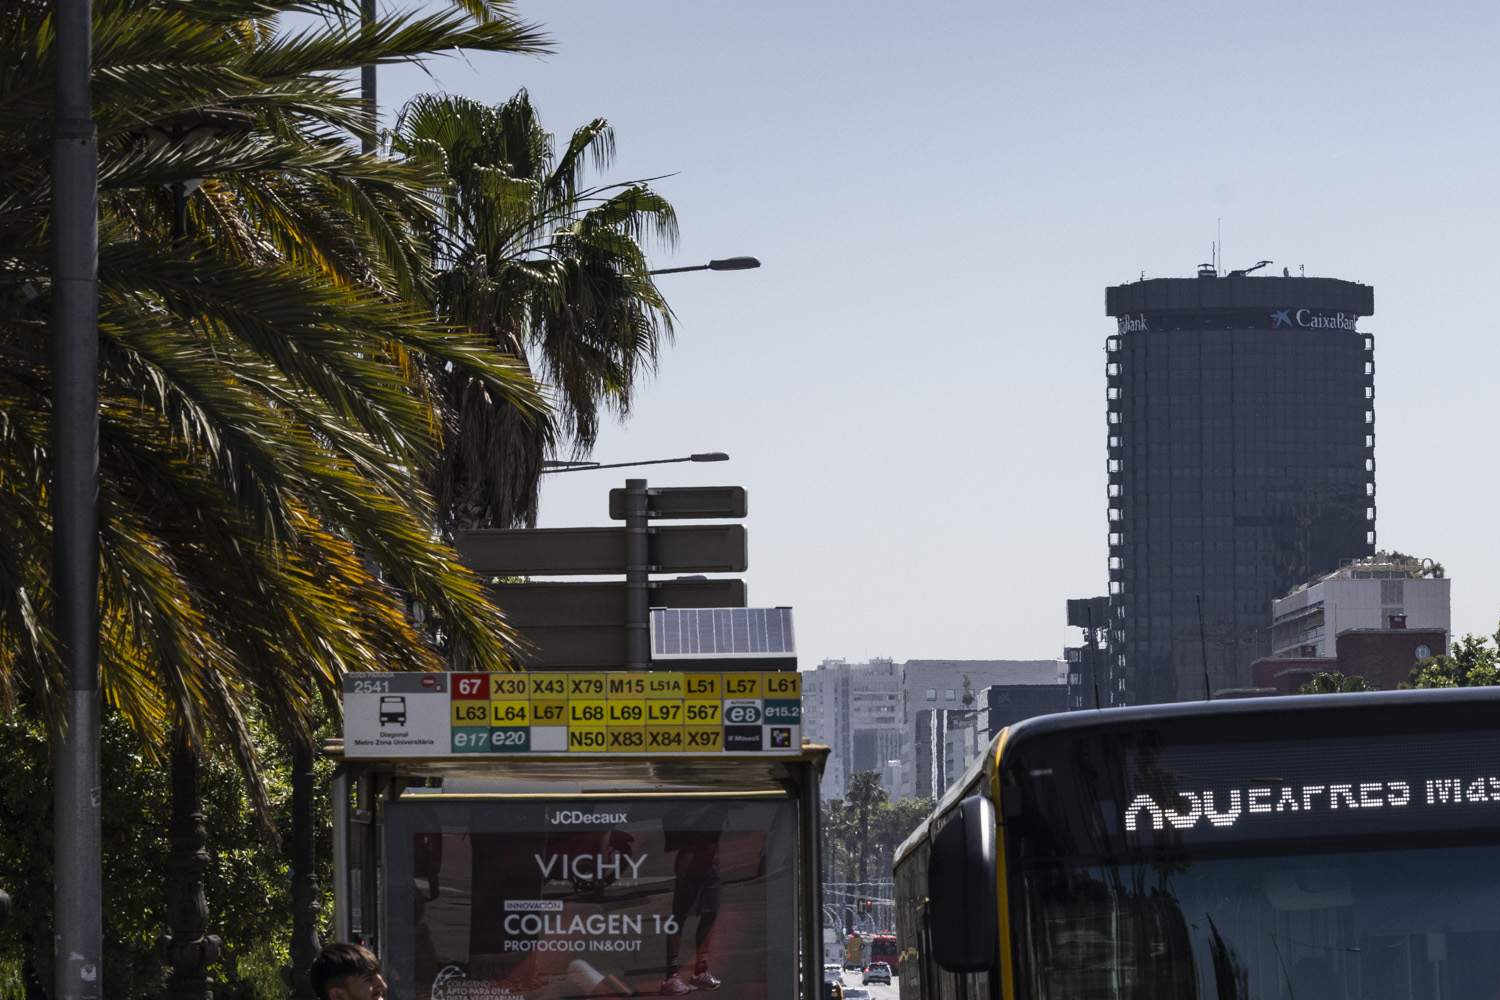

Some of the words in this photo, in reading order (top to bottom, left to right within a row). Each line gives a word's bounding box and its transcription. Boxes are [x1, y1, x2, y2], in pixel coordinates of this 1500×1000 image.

[1296, 309, 1357, 331] CaixaBank
[354, 681, 389, 693] 2541
[459, 679, 481, 694] 67
[494, 680, 526, 694] X30
[533, 680, 565, 694] X43
[571, 680, 603, 694] X79
[610, 679, 645, 693] M15
[650, 681, 681, 691] L51A
[687, 680, 714, 693] L51
[727, 680, 756, 693] L57
[768, 679, 797, 692] L61
[456, 707, 487, 720] L63
[494, 707, 527, 721] L64
[534, 706, 564, 720] L67
[572, 706, 604, 720] L68
[610, 706, 642, 720] L69
[648, 705, 681, 720] L97
[687, 705, 719, 720] 567
[731, 707, 756, 721] e8
[765, 707, 800, 717] e15.2
[454, 733, 488, 747] e17
[492, 731, 525, 745] e20
[571, 732, 605, 747] N50
[610, 732, 644, 746] X83
[649, 732, 682, 746] X84
[687, 732, 720, 746] X97
[551, 811, 628, 824] JCDecaux
[534, 853, 648, 880] VICHY
[504, 914, 642, 935] COLLAGEN
[652, 914, 679, 935] 16
[504, 940, 586, 951] PROTOCOLO
[589, 940, 642, 951] IN&OUT
